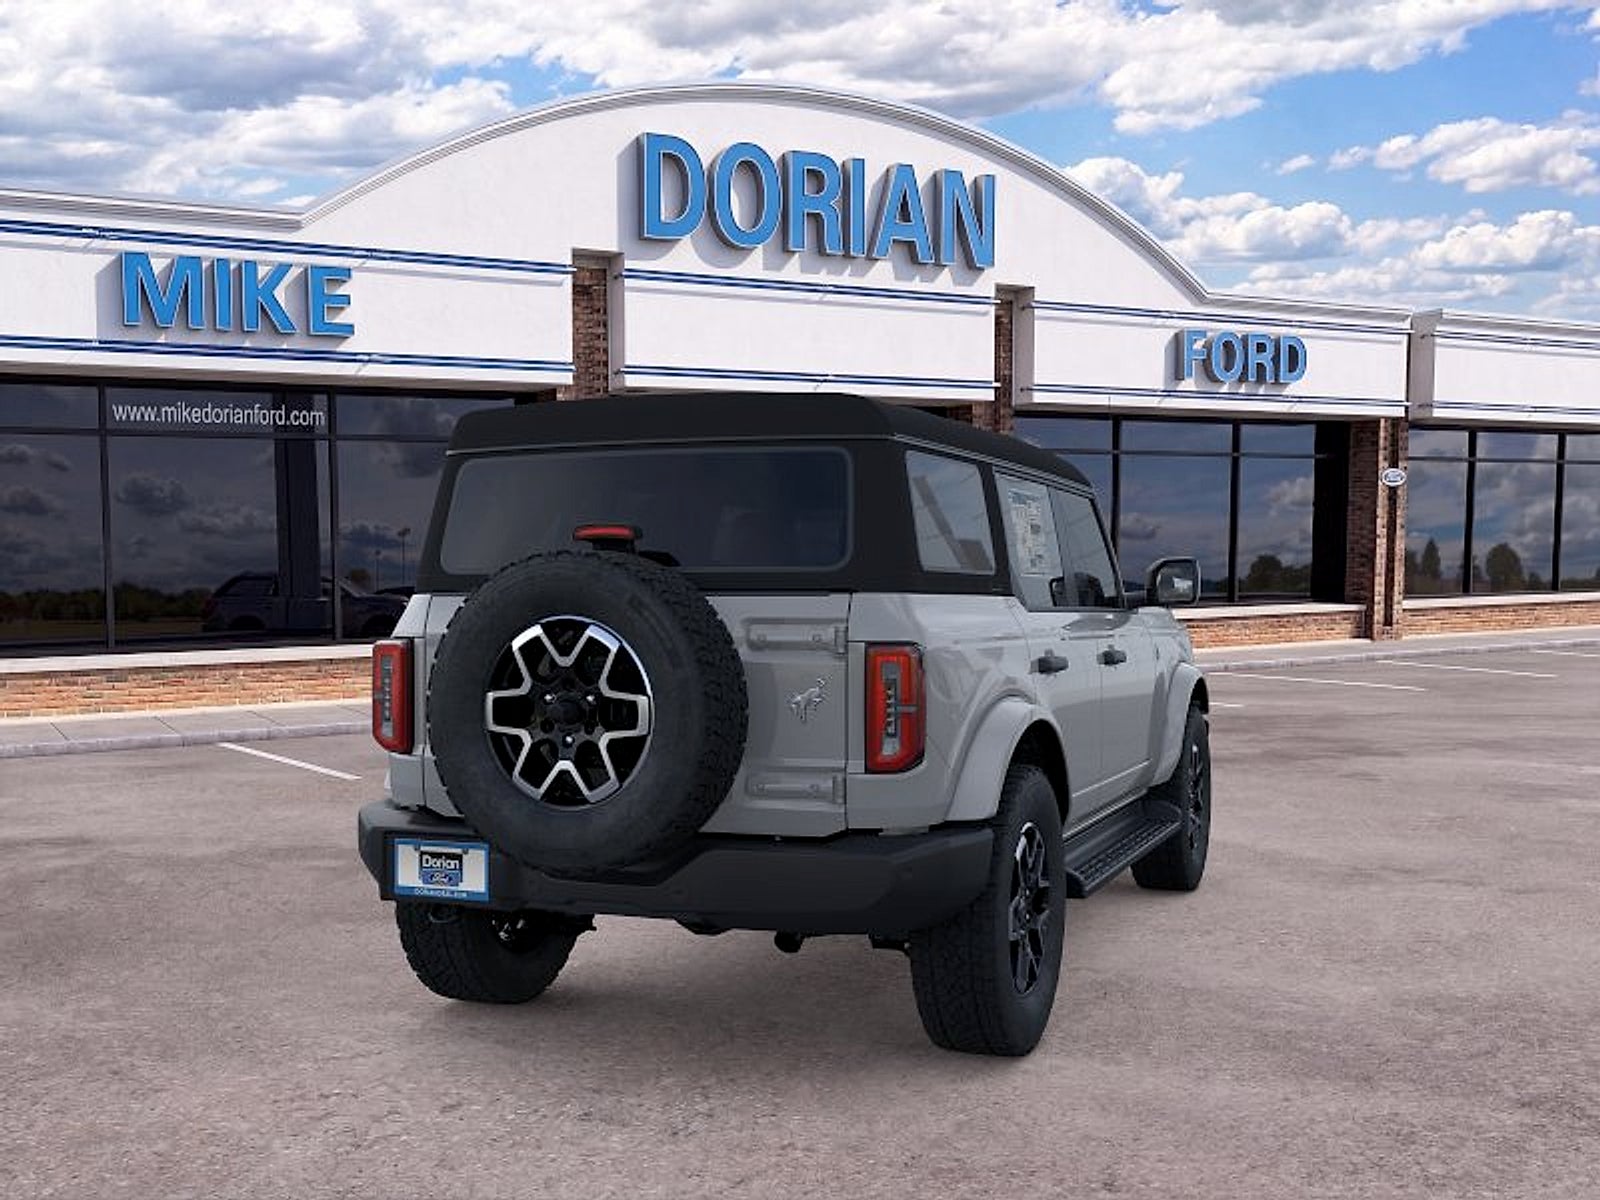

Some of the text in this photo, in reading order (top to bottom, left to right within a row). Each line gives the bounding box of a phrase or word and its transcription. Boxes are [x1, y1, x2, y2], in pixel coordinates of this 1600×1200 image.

[640, 132, 995, 270] DORIAN
[121, 252, 355, 336] MIKE
[1177, 328, 1307, 384] FORD
[112, 402, 326, 426] www.mikedorianford.com
[422, 854, 460, 870] Dorian
